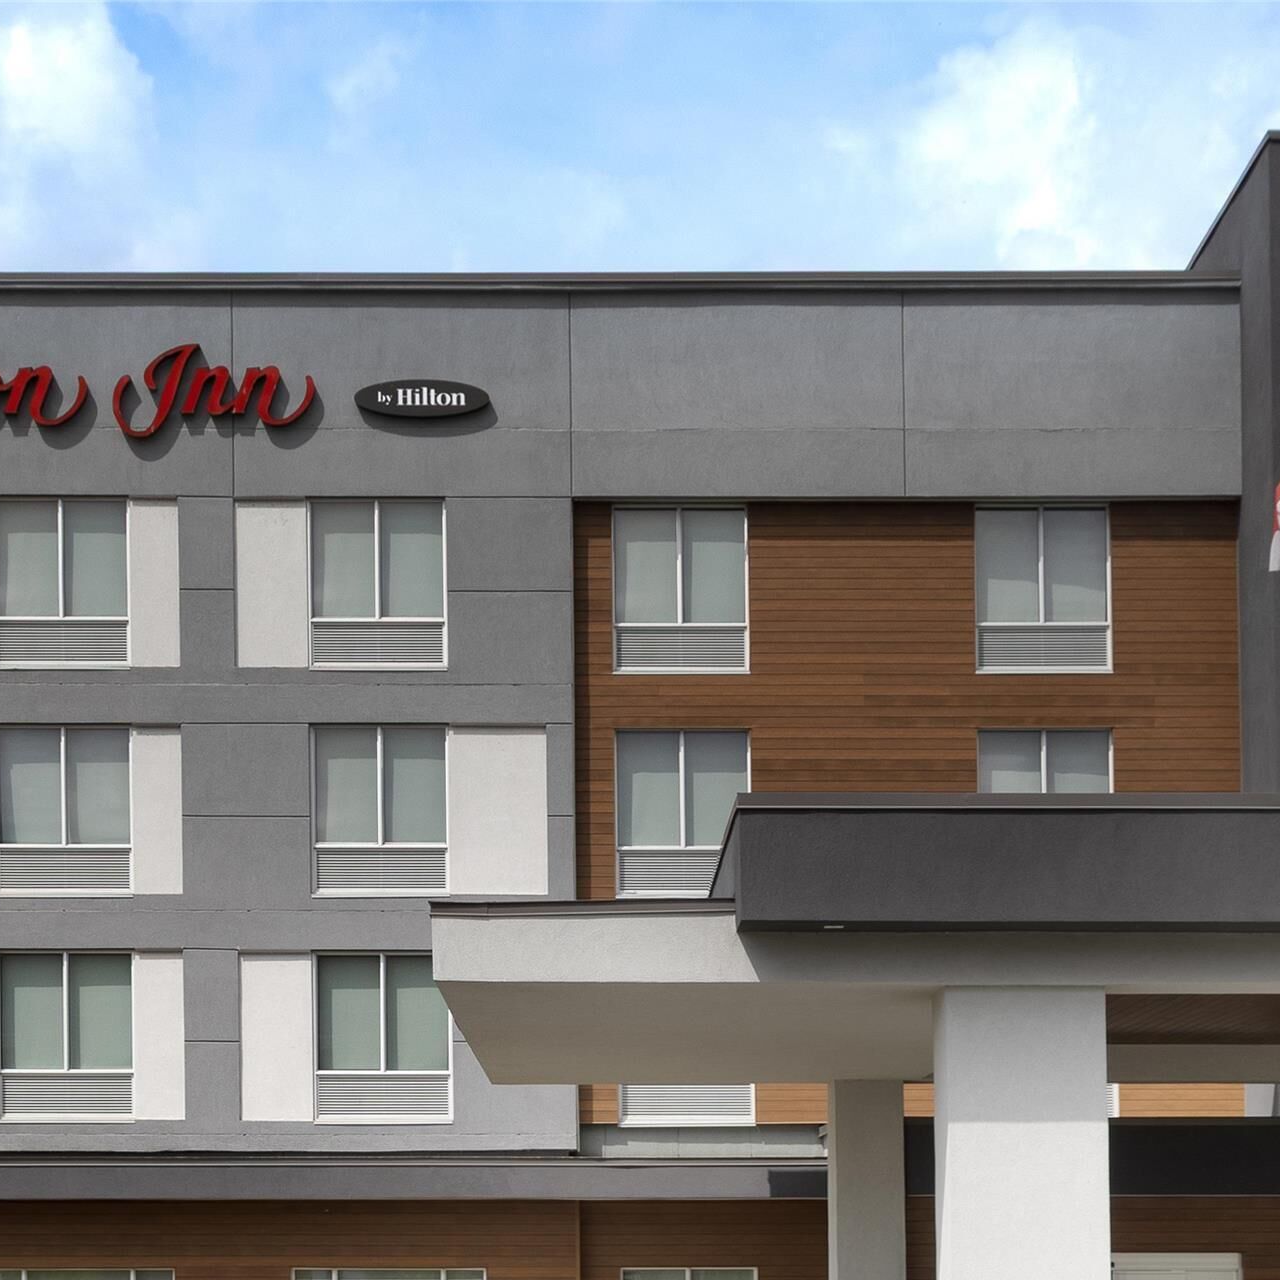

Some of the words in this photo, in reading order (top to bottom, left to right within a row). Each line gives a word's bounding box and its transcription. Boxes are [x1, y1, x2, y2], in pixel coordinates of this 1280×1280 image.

[113, 343, 315, 437] Inn
[377, 391, 392, 405] by
[396, 386, 466, 406] Hilton
